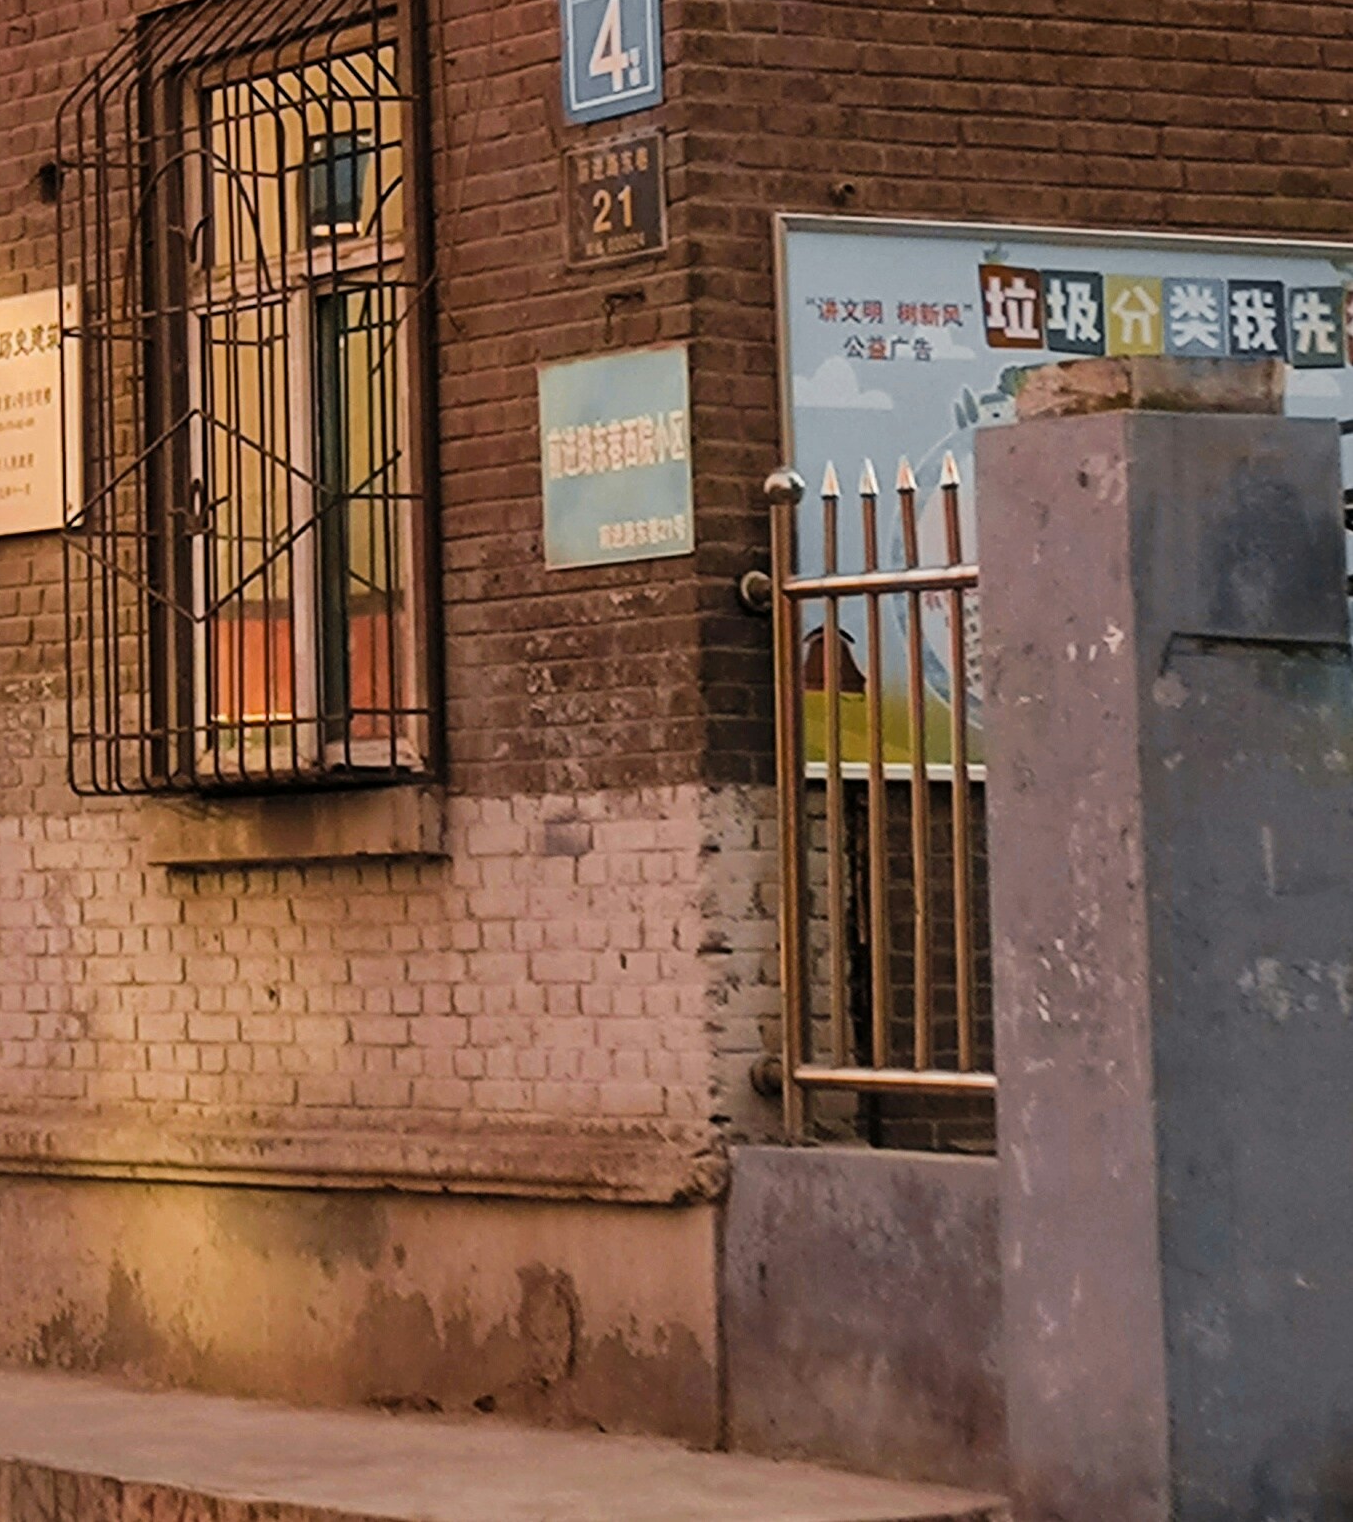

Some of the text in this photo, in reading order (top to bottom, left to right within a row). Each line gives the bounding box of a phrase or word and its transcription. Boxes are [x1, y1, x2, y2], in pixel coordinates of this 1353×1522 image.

[593, 184, 633, 234] 21
[985, 275, 1353, 354] 垃圾分类我先
[843, 334, 933, 362] 公益广告
